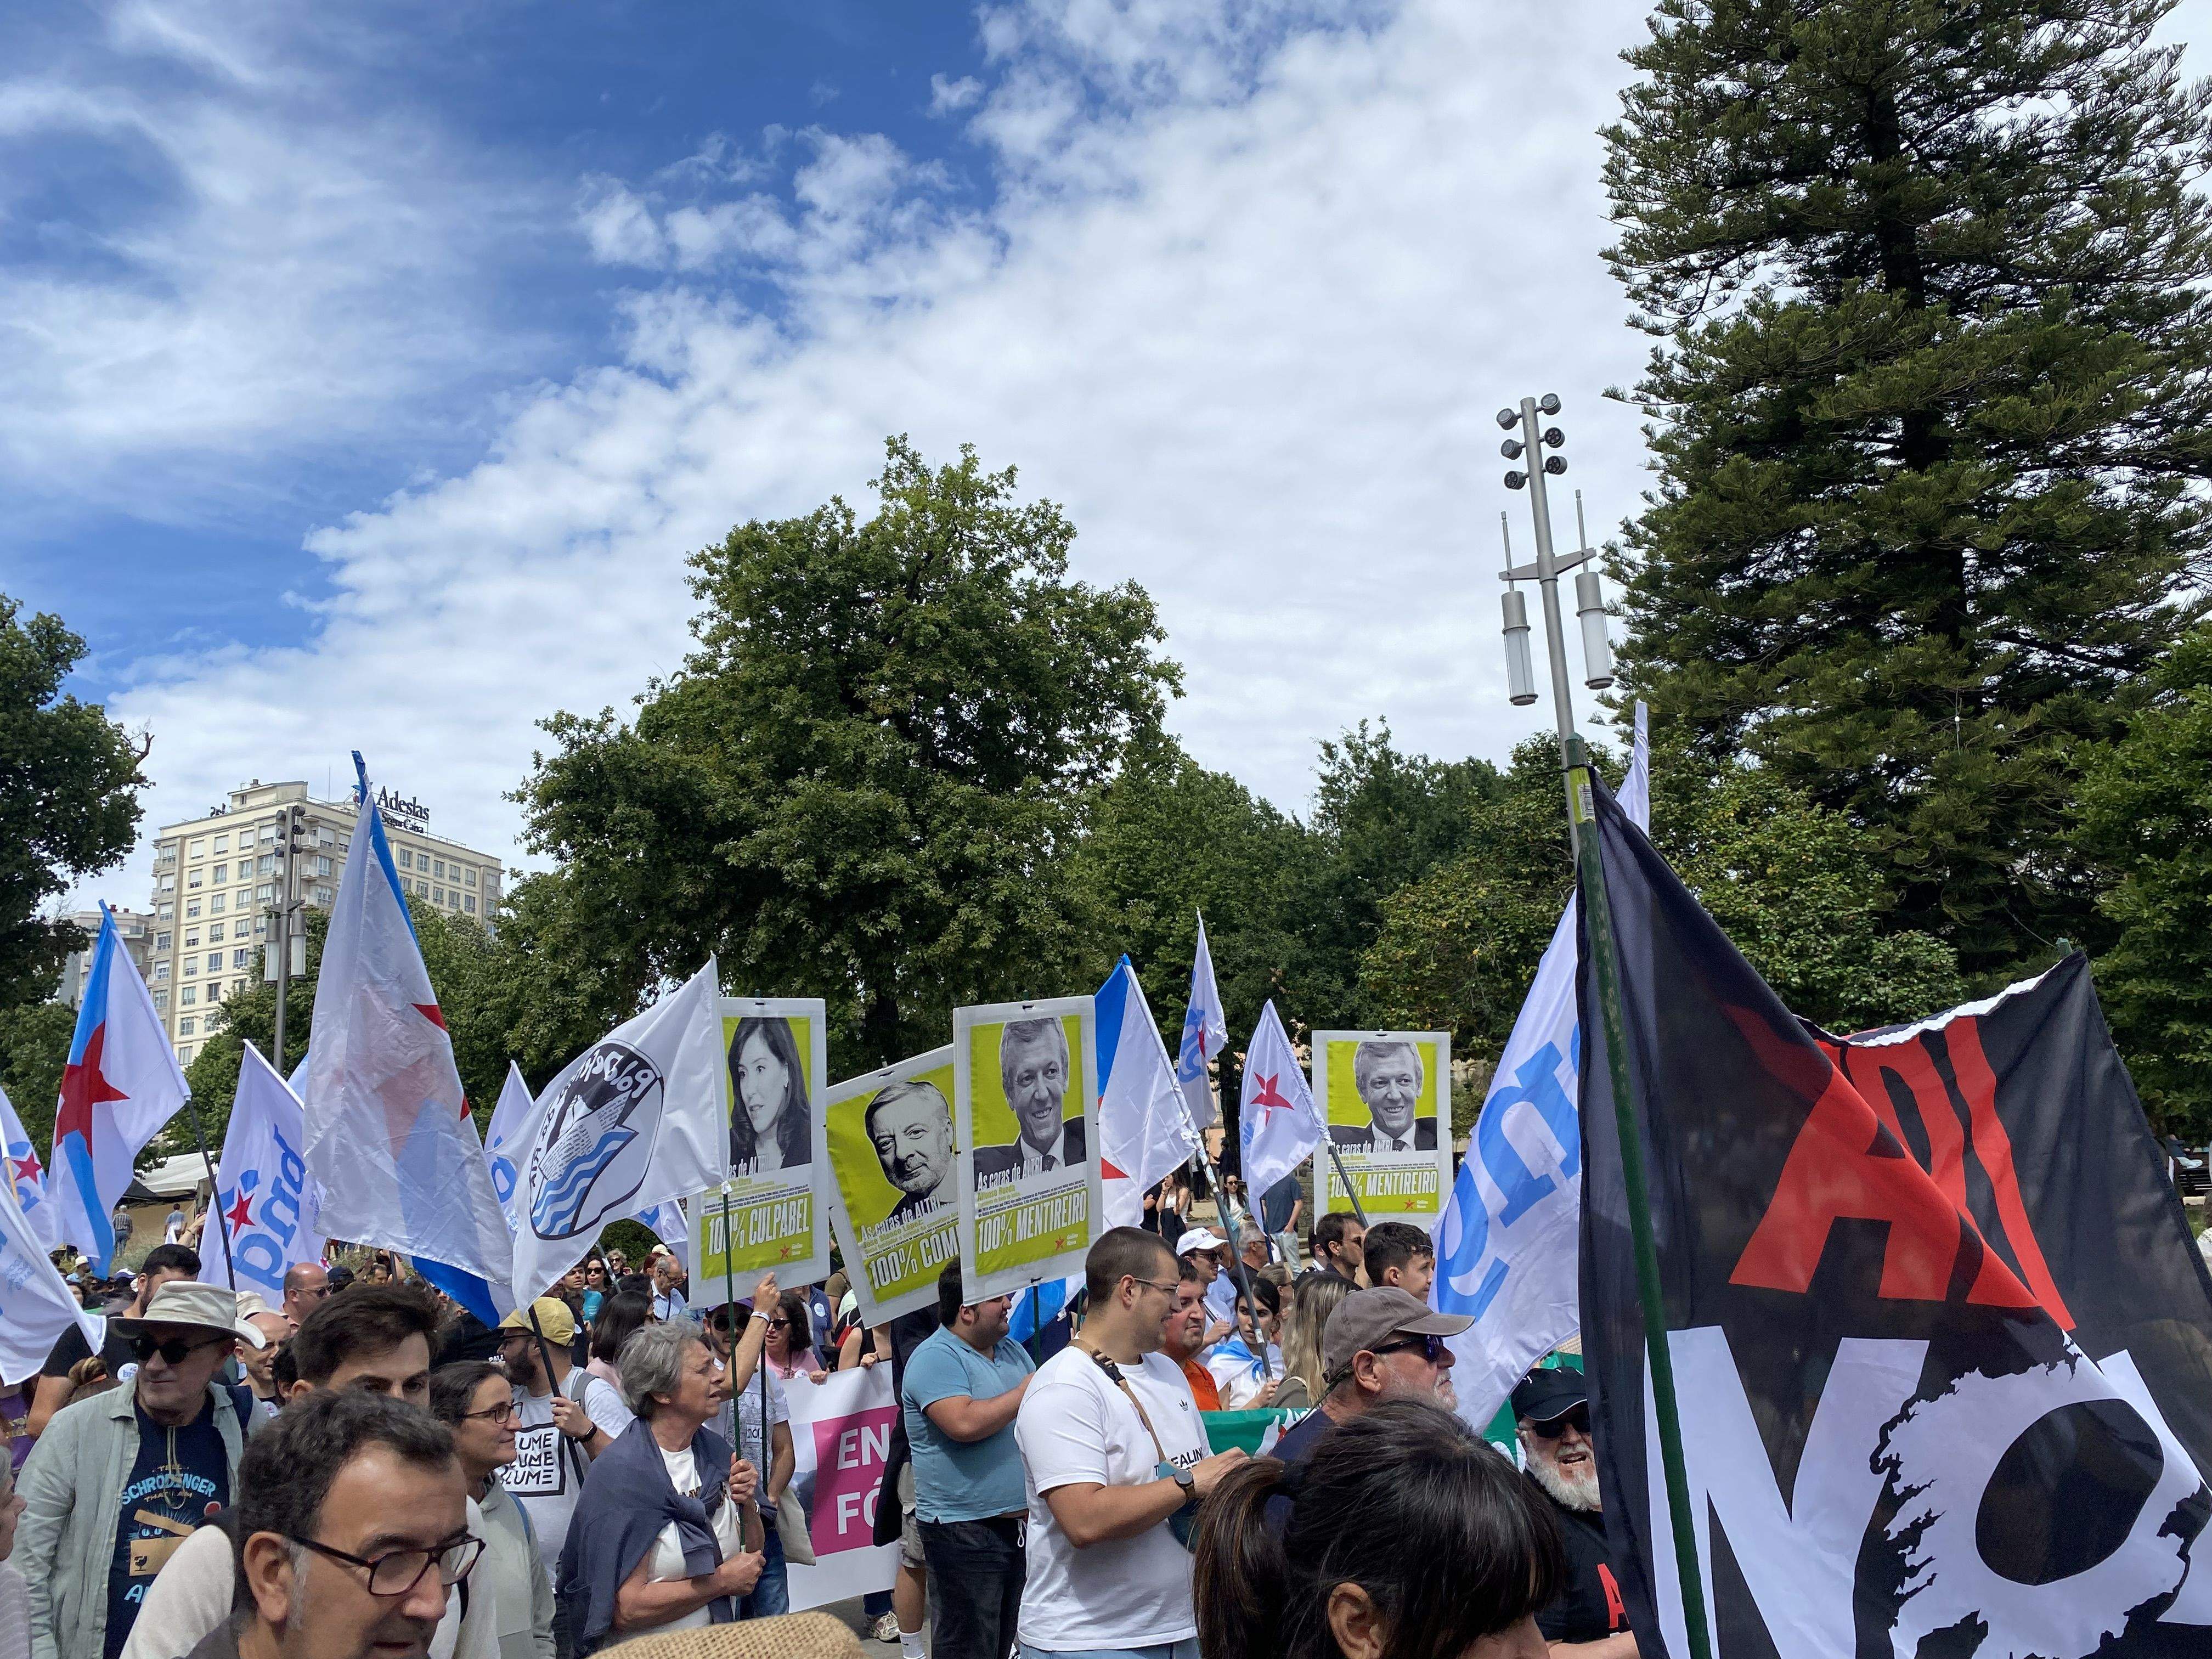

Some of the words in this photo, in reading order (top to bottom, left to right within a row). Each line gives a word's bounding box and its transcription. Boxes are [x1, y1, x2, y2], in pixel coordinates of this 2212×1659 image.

[376, 785, 430, 820] Adeslas
[1342, 1142, 1362, 1154] caras
[1363, 1140, 1372, 1154] de
[978, 1171, 988, 1192] As
[989, 1169, 1011, 1189] caras
[1011, 1161, 1022, 1182] de
[1365, 1170, 1438, 1197] MENTIREIRO
[748, 1198, 810, 1246] CULPÁBEL
[860, 1224, 872, 1242] As
[874, 1214, 901, 1235] caras
[901, 1207, 914, 1226] de
[978, 1211, 1013, 1255] 100%
[1016, 1189, 1087, 1243] MENTIREIRO
[869, 1244, 918, 1290] 100%
[518, 1432, 554, 1451] UME
[837, 1476, 883, 1535] FÓ
